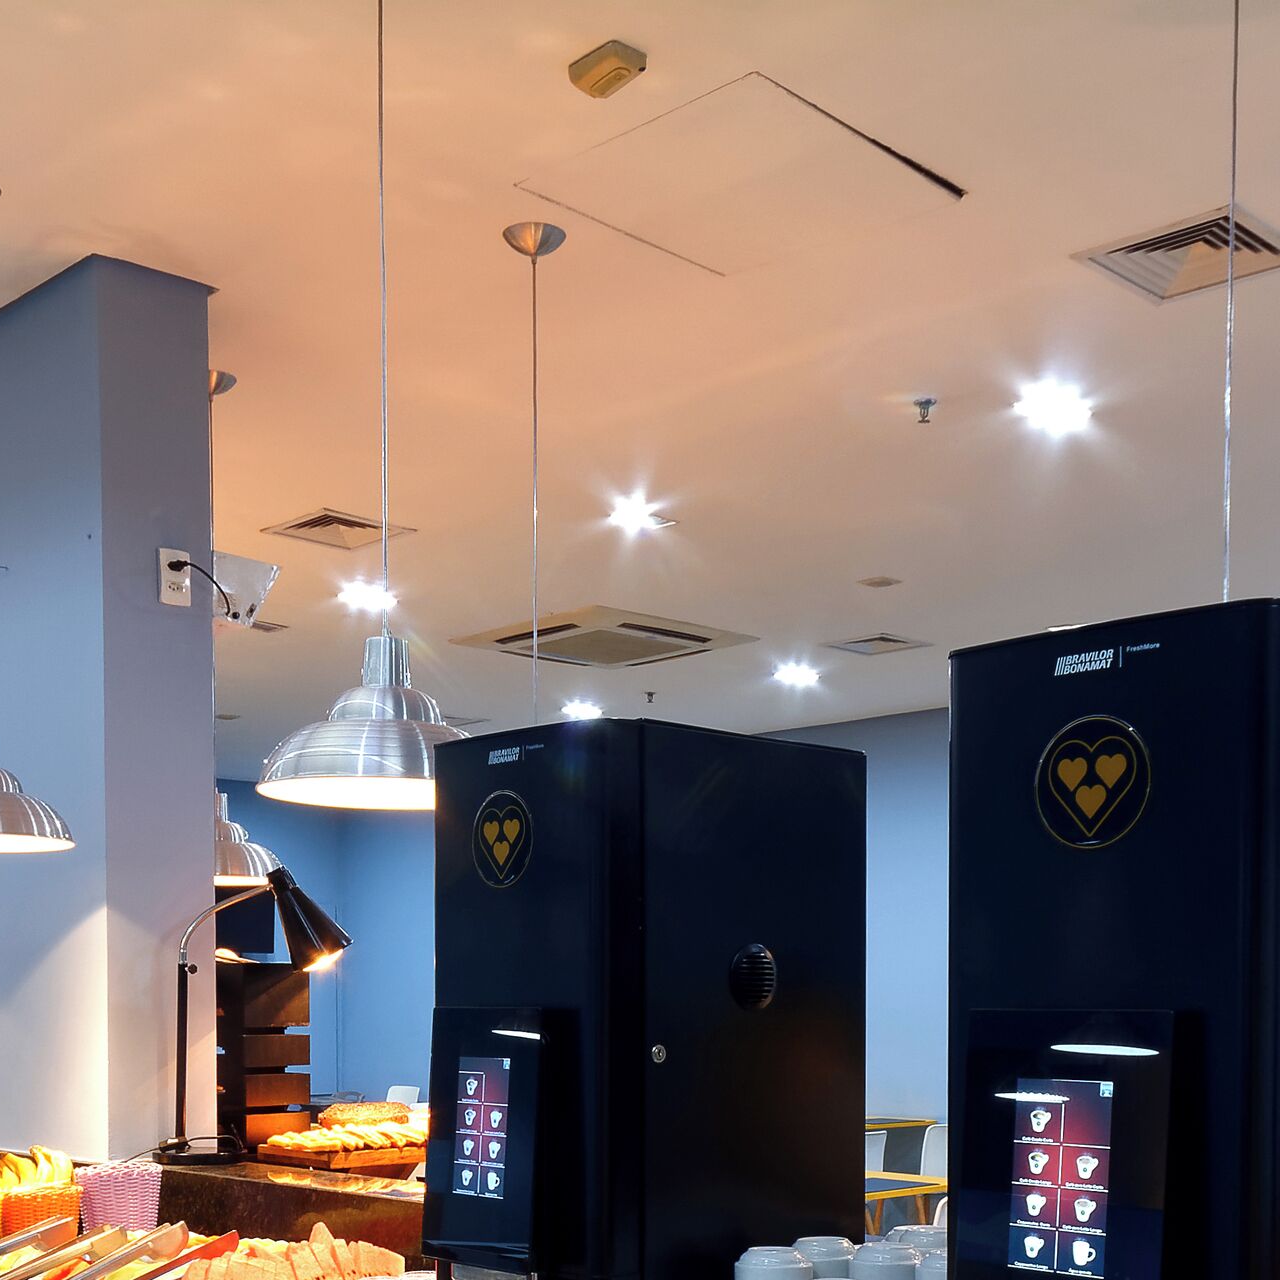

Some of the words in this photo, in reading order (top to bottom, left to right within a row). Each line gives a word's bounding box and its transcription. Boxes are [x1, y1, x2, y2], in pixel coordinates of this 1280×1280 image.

[1126, 643, 1160, 652] FreshMore
[1064, 649, 1114, 665] BRAVILOR
[1063, 658, 1113, 675] BONAMAT
